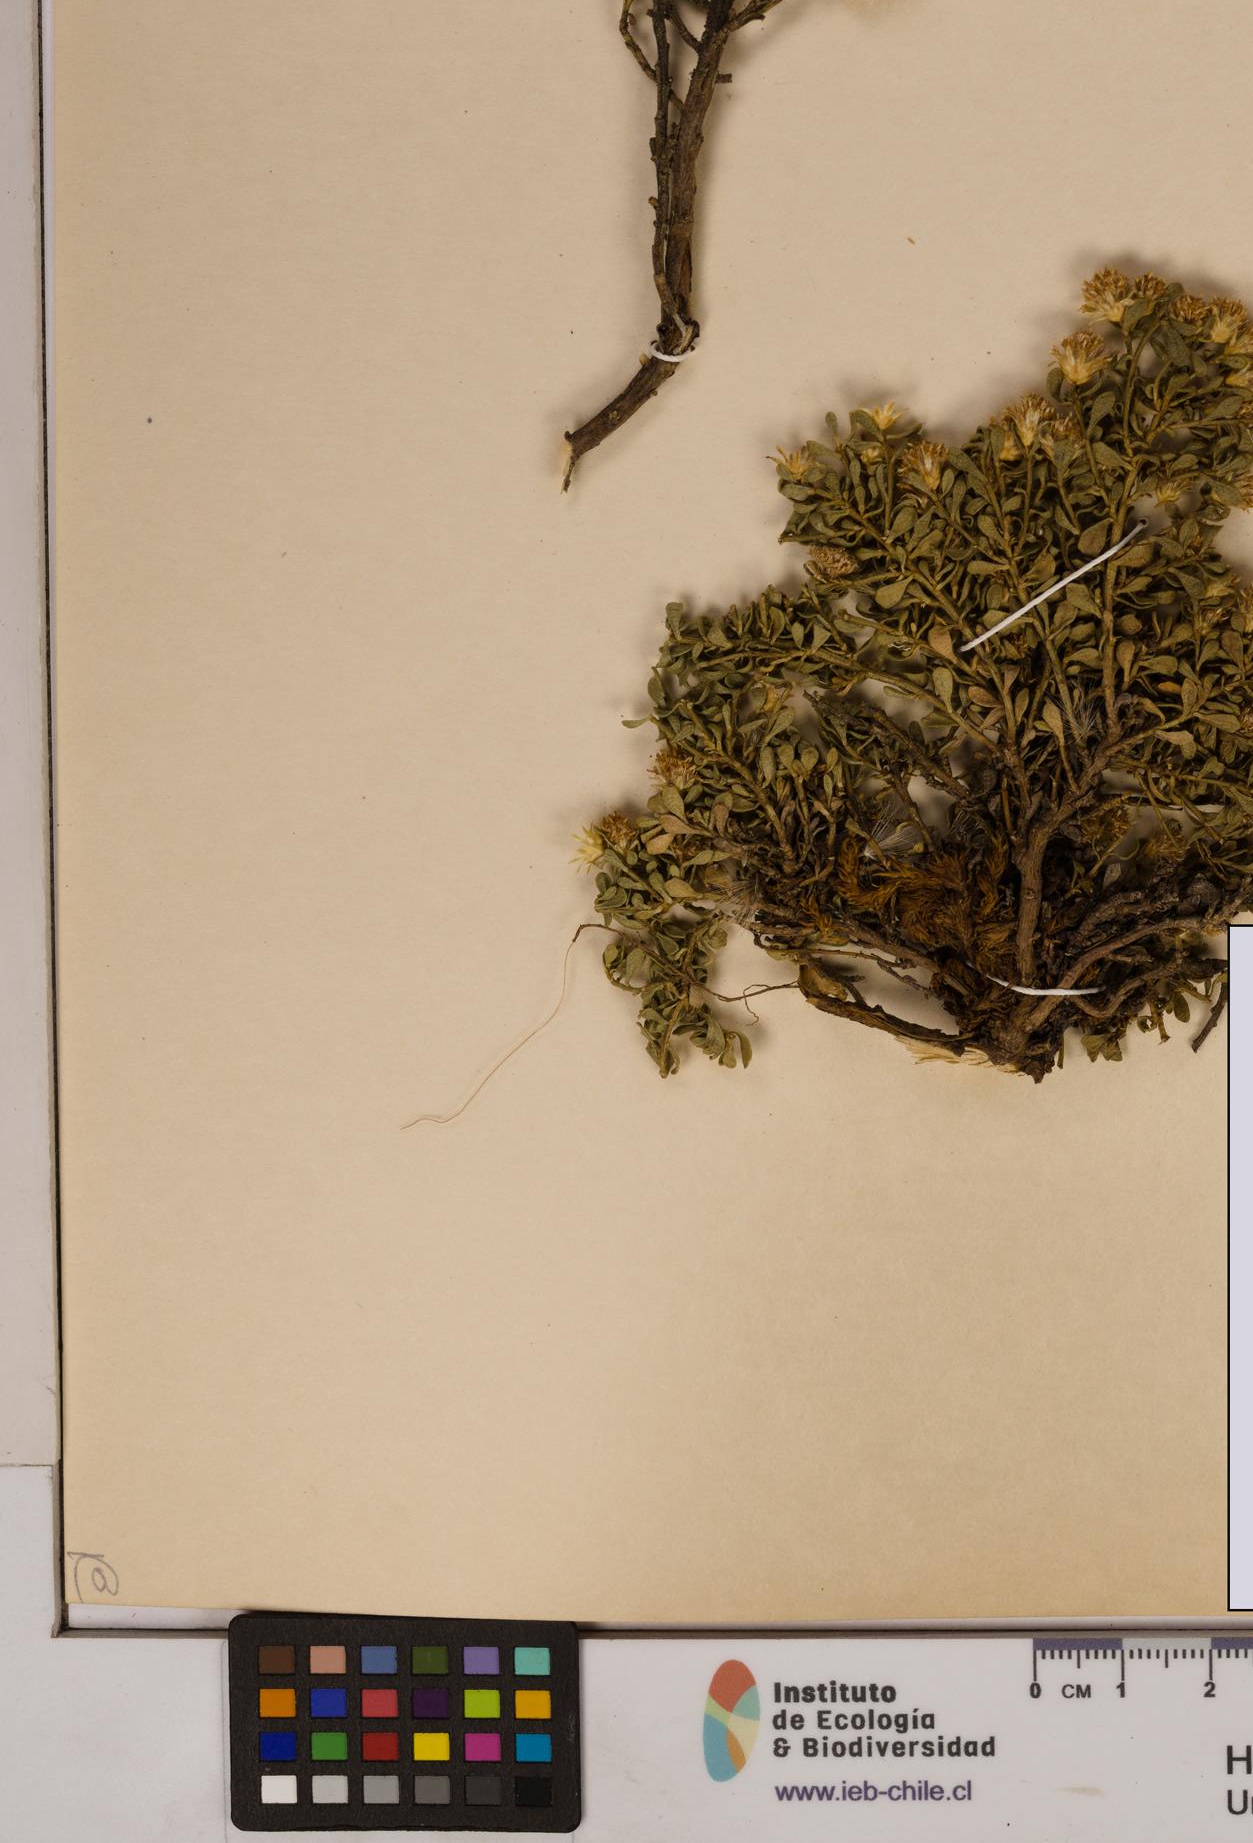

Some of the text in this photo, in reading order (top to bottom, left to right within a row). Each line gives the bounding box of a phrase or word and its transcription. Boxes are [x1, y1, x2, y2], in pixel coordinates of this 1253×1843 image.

[773, 1679, 897, 1704] Instituto
[1029, 1682, 1042, 1699] 0
[1061, 1683, 1092, 1699] CM
[1116, 1681, 1126, 1699] 1
[1203, 1681, 1216, 1698] 2
[772, 1707, 935, 1734] de Ecología
[772, 1735, 996, 1758] & Biodiversidad
[774, 1779, 972, 1802] www.ieb-chile.cl
